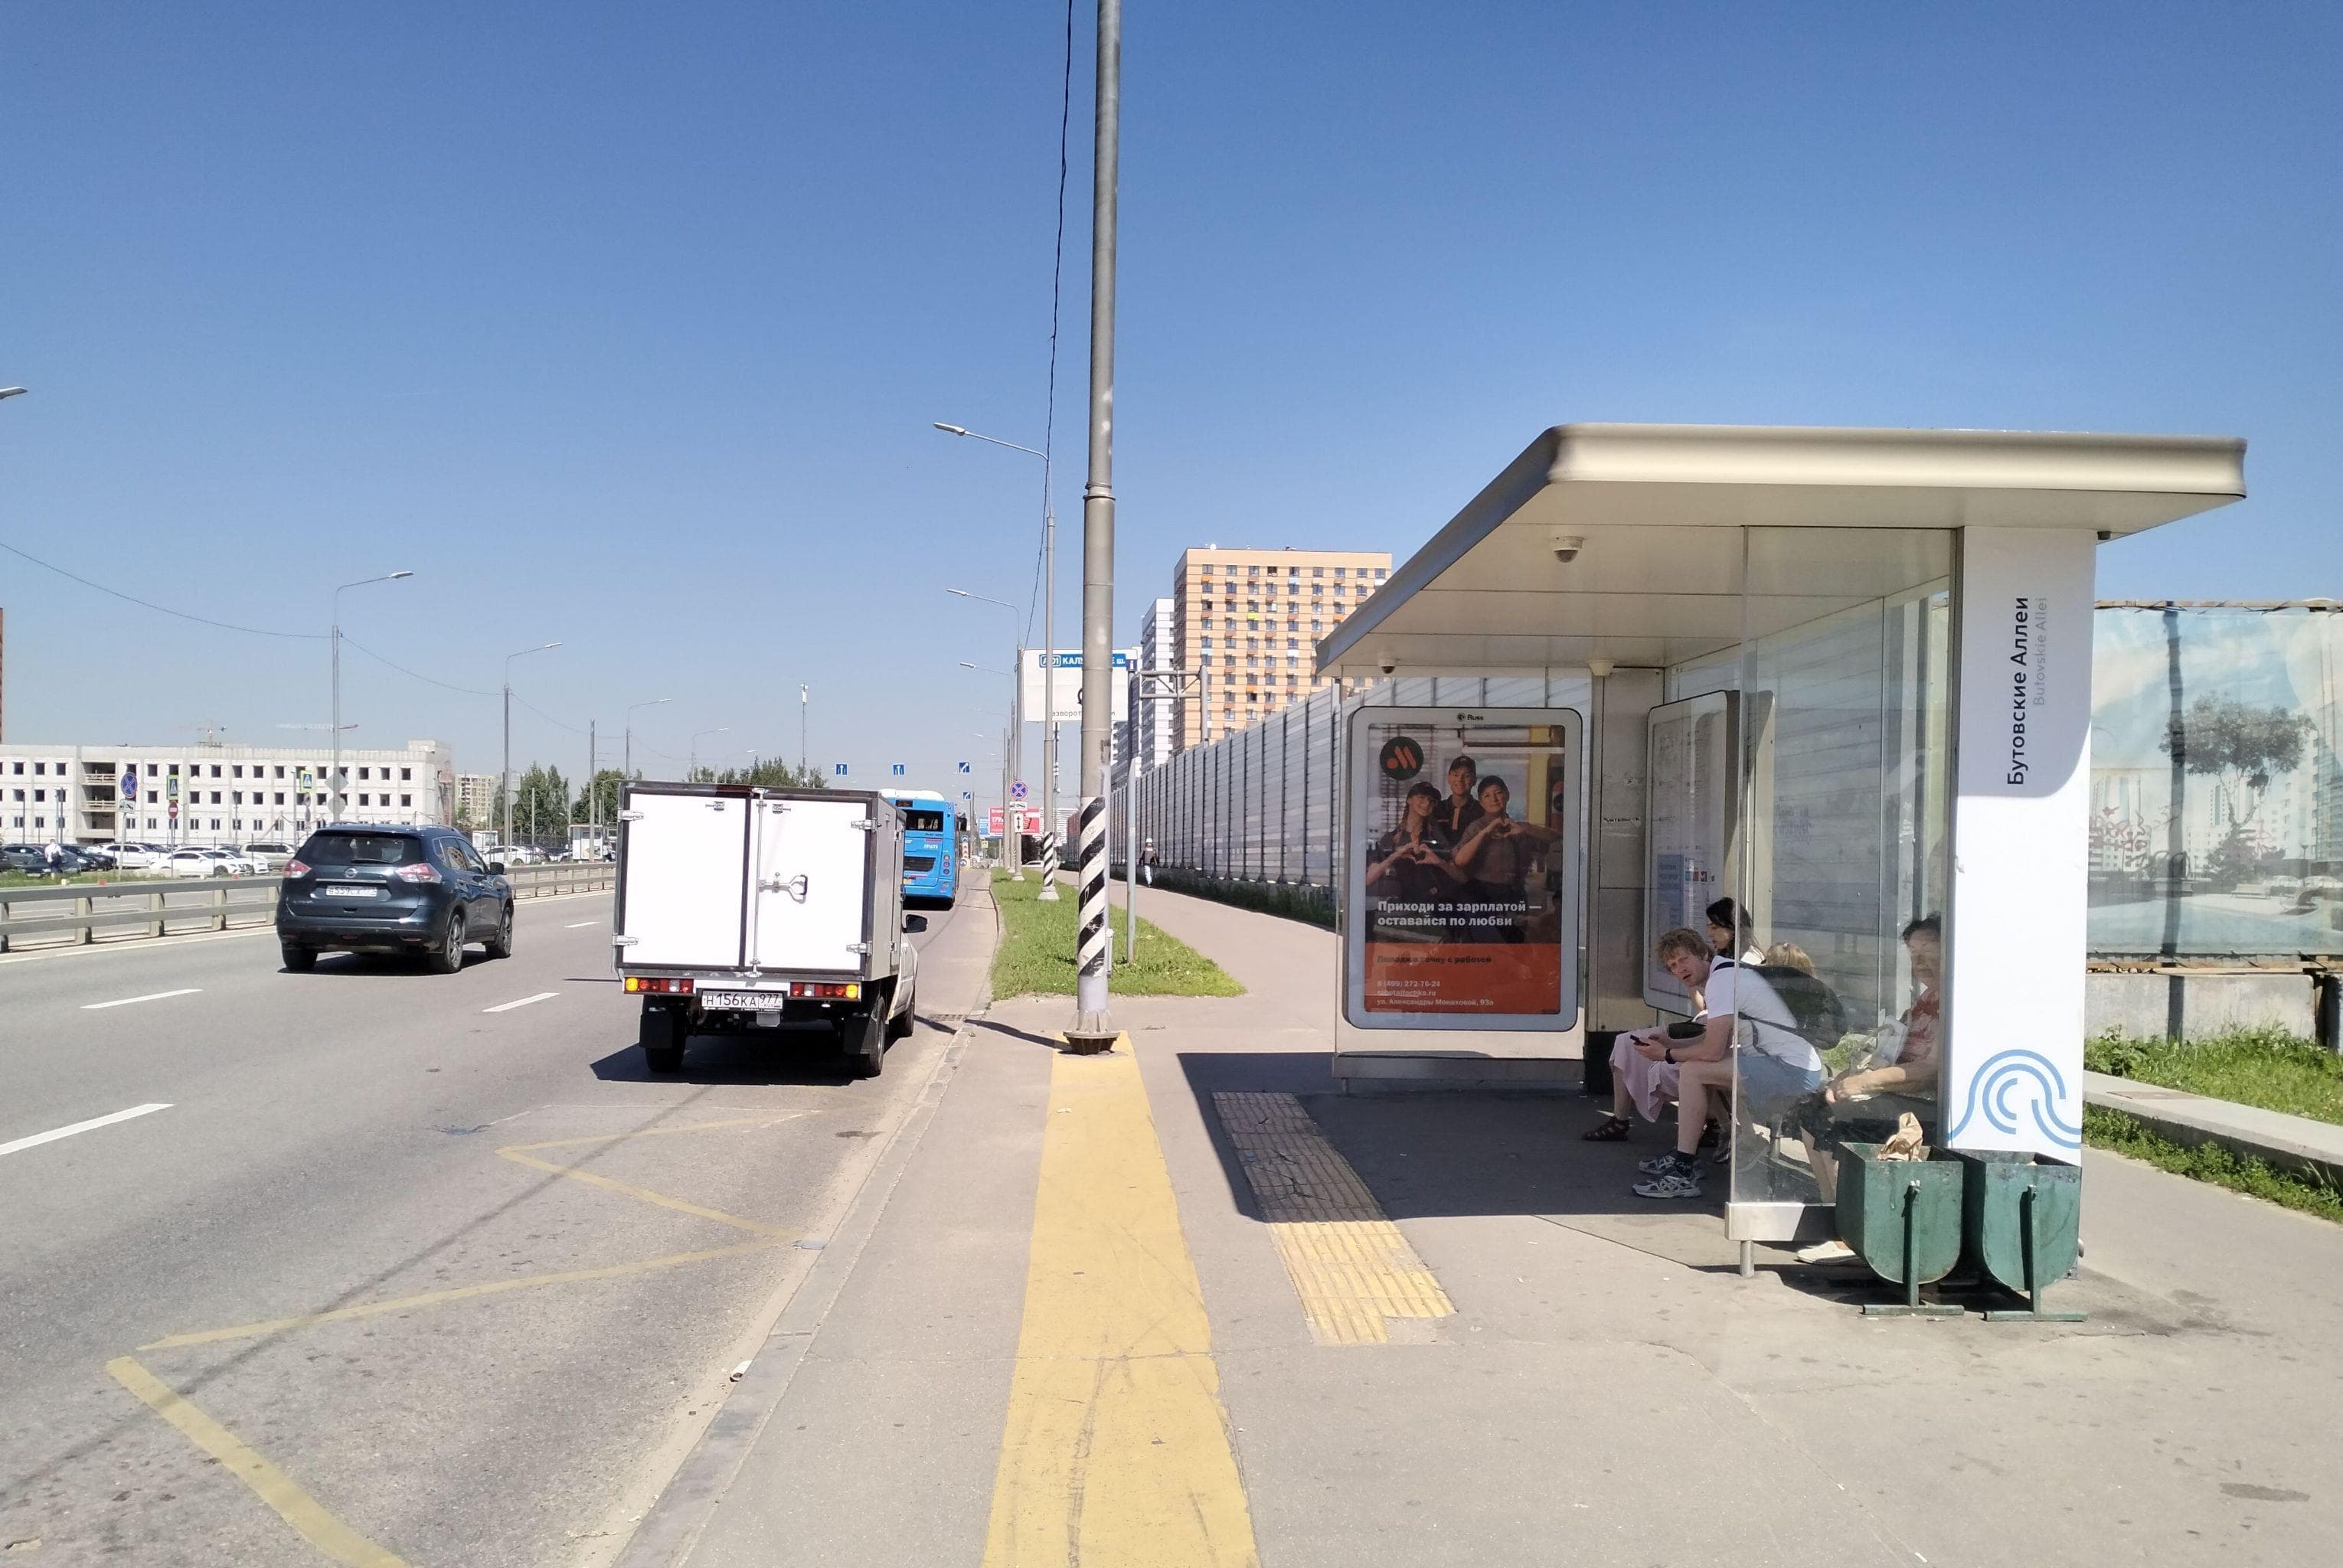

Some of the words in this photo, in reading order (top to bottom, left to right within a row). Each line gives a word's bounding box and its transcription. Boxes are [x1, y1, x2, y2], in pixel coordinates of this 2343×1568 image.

[2034, 597, 2047, 632] Allei
[2010, 597, 2029, 666] Аллеи
[2033, 635, 2047, 706] Butovskie
[2007, 671, 2028, 785] Бутовские
[1377, 900, 1435, 913] Приходи
[1438, 903, 1453, 912] за
[1456, 900, 1526, 913] зарплатой
[1377, 916, 1446, 926] оставайся
[1449, 917, 1466, 926] по
[1468, 916, 1513, 926] любви
[1455, 956, 1492, 964] работой
[760, 994, 779, 1004] 977
